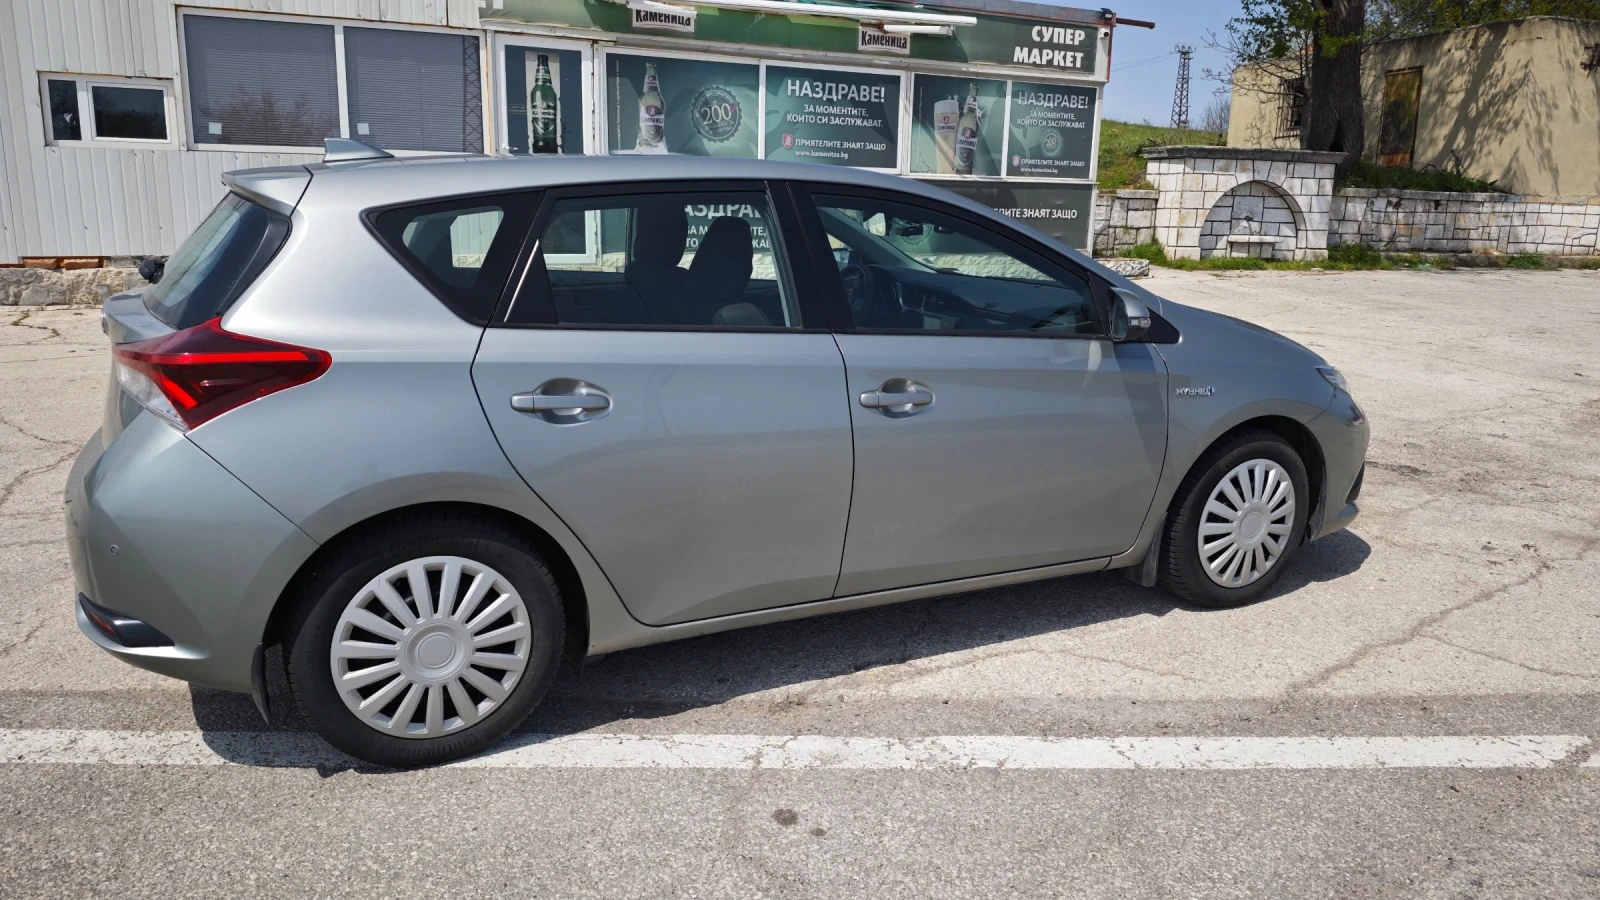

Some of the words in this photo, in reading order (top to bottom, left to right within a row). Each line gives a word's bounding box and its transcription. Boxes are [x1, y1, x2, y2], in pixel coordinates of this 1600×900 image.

[636, 9, 691, 27] Каменица
[861, 30, 908, 50] Каменица
[1031, 25, 1086, 46] СУПЕР
[1013, 46, 1084, 68] МАРКЕТ
[787, 79, 885, 103] НАЗДРАВЕ!
[1018, 91, 1089, 109] НАЗДРАВЕ!
[701, 103, 732, 125] 200
[803, 104, 815, 113] ЗА
[815, 105, 869, 117] МОМЕНТИТЕ,
[1029, 110, 1037, 118] ЗА
[1037, 111, 1076, 121] МОМЕНТИТЕ,
[786, 113, 816, 123] КОИТО
[816, 115, 828, 125] СИ
[829, 116, 884, 128] ЗАСЛУЖАВАТ.
[1016, 118, 1038, 126] КОИТО
[1038, 119, 1047, 127] СИ
[1047, 119, 1087, 129] ЗАСЛУЖАВАТ.
[795, 138, 841, 149] ПРИЯТЕЛИТЕ
[842, 141, 864, 150] ЗНАЯТ
[864, 142, 886, 151] ЗАЩО
[795, 150, 849, 160] www.kamenitza.bg
[1020, 158, 1053, 166] ПРИЯТЕЛИТЕ
[1069, 160, 1085, 168] ЗАЩО
[993, 208, 1021, 218] ЛИТЕ
[1022, 208, 1050, 218] ЗНАЯТ
[1051, 209, 1078, 219] ЗАЩО
[1176, 387, 1209, 396] HYBRID
